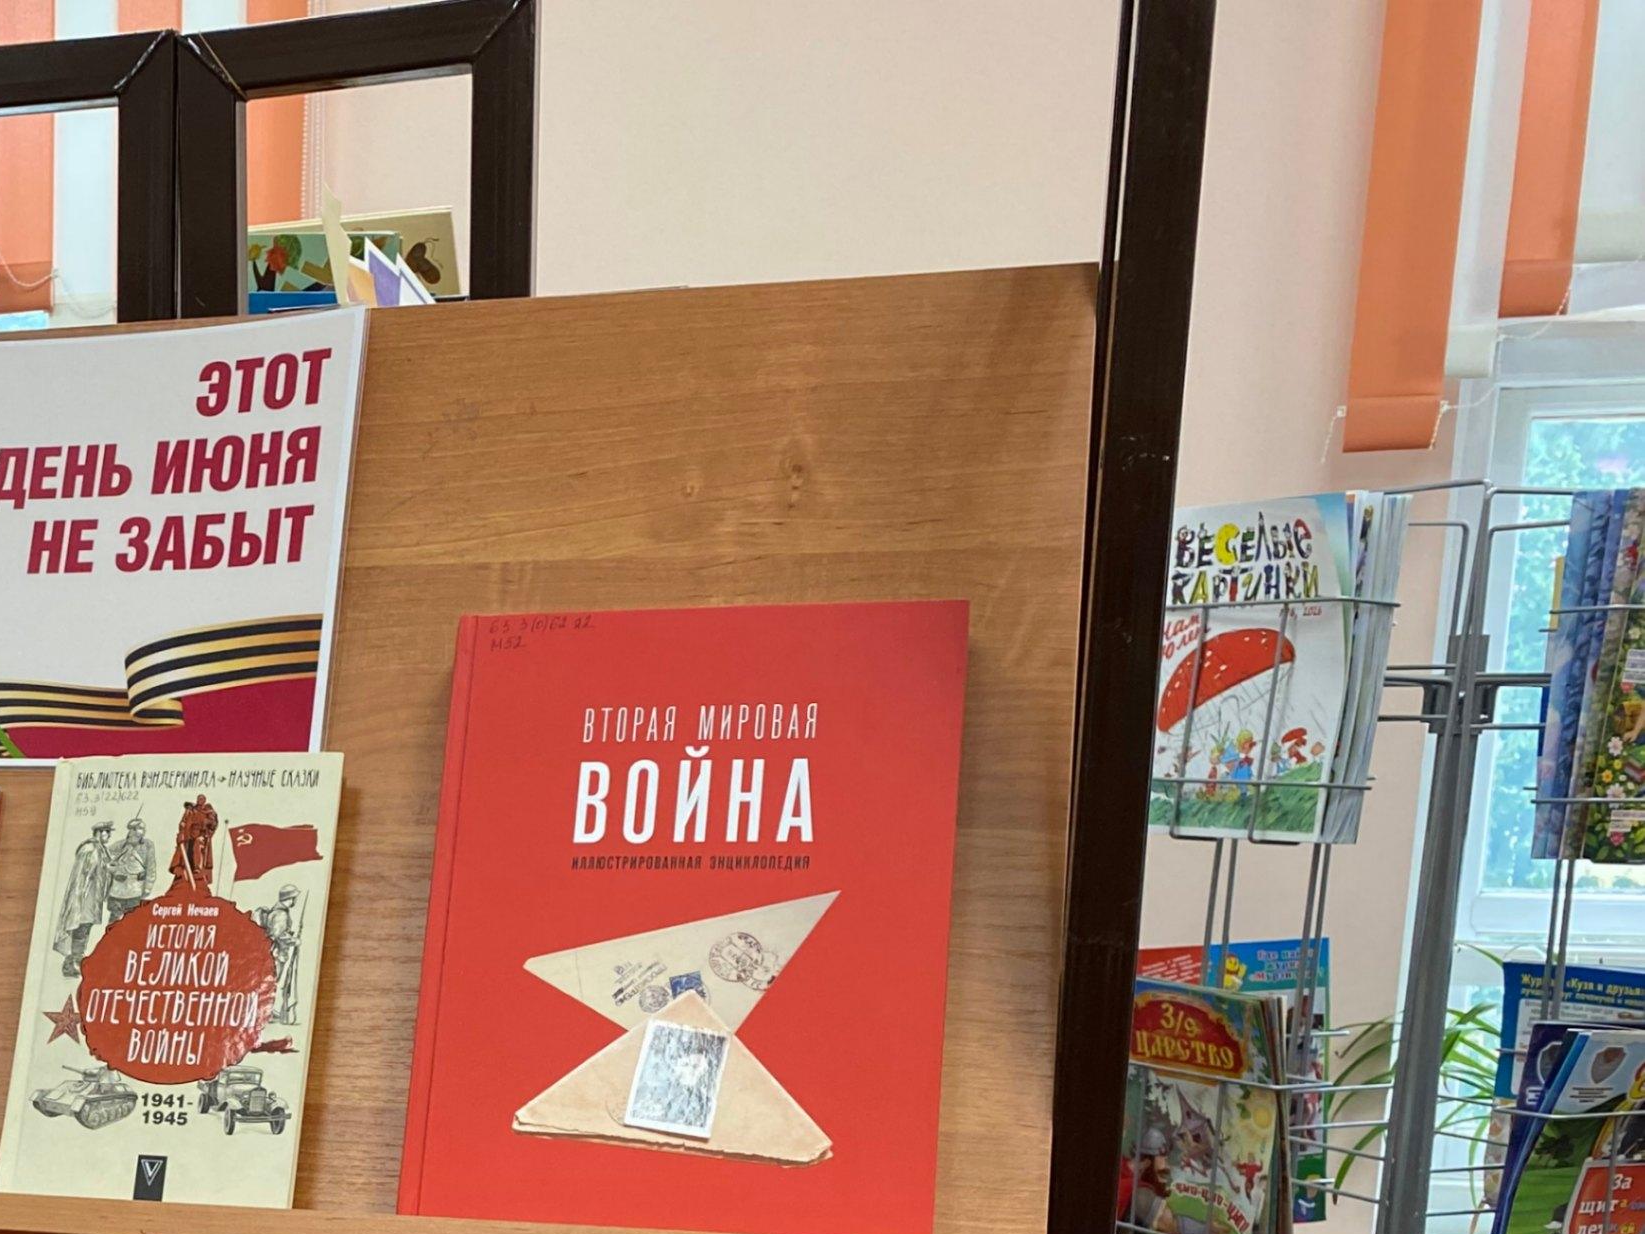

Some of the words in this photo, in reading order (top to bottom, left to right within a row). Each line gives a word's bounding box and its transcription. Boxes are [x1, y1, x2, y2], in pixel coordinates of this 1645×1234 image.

[195, 347, 332, 418] ЭТОТ
[151, 426, 322, 496] ИЮНЯ
[27, 517, 95, 575] НЕ
[115, 504, 315, 572] ЗАБЫТ
[1171, 561, 1320, 605] КАРТИНКИ
[583, 706, 677, 744] ВТОРАЯ
[698, 703, 819, 743] МИРОВАЯ
[76, 771, 137, 789] БИБЛИОТЕКА
[140, 770, 216, 789] ВУНДЕРКИНДА
[228, 769, 275, 788] НАУЧНЫЕ
[281, 769, 320, 788] СКАЗКИ
[573, 744, 815, 844] ВОЙНА
[571, 854, 702, 872] ИЛЛЮСТРИРОВАННАЯ
[710, 854, 811, 873] ЭНЦИКЛОПЕДИЯ
[152, 903, 182, 918] Сергей
[187, 904, 219, 917] Нечаев
[145, 923, 216, 950] ИСТОРИЯ
[124, 949, 229, 985] ВЕЛИКОЙ
[85, 988, 259, 1027] ОТЕЧЕСТВЕННОЙ
[127, 1027, 205, 1065] ВОЙНЫ
[140, 1093, 193, 1109] 1941-
[141, 1110, 188, 1126] 1945
[1612, 1173, 1633, 1190] За
